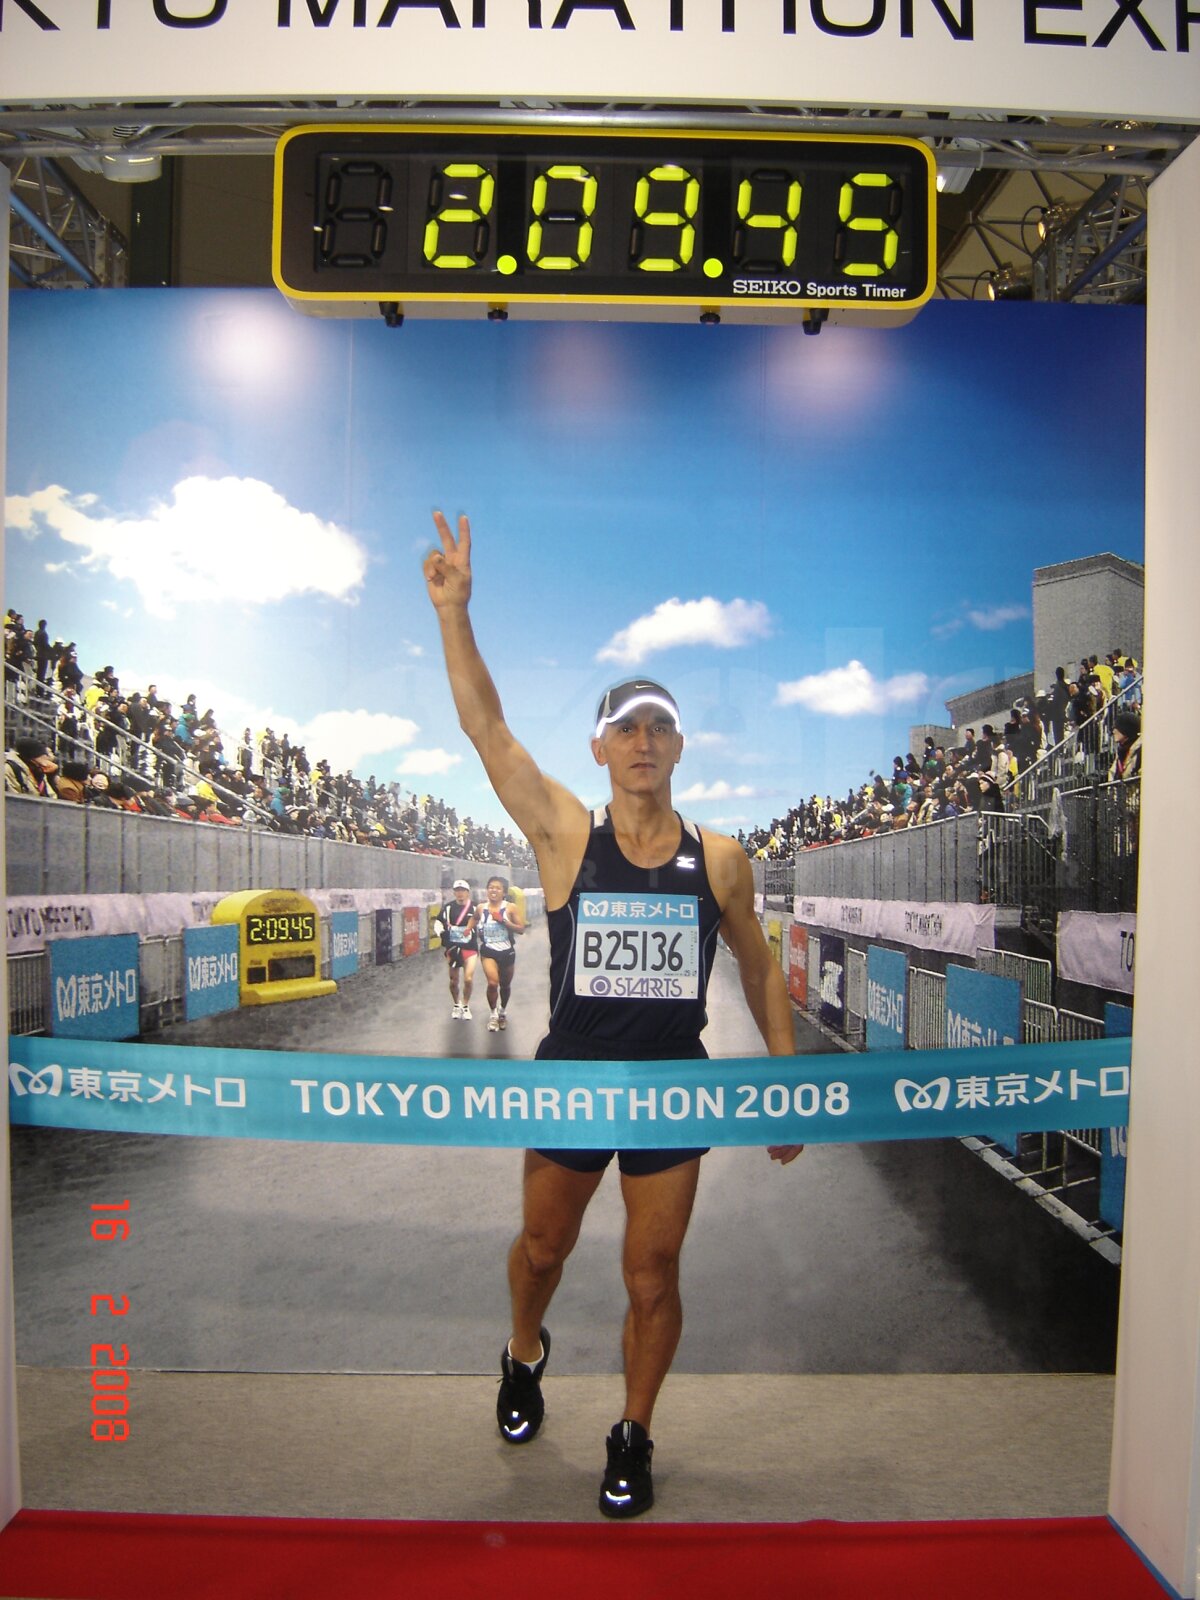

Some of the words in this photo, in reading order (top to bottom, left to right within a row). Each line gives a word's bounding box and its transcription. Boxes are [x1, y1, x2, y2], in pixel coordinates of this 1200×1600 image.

[732, 279, 801, 295] SEIKO
[806, 282, 858, 298] Sports
[861, 283, 907, 298] Timer
[610, 901, 694, 919] 東京メトロ
[583, 930, 683, 972] B25136
[78, 968, 136, 1016] 東京メトロ
[67, 1067, 246, 1108] 東京メトロ
[290, 1079, 451, 1120] TOKYO
[463, 1085, 724, 1121] MARATHON
[735, 1081, 850, 1119] 2008
[955, 1066, 1129, 1109] 東京メトロ
